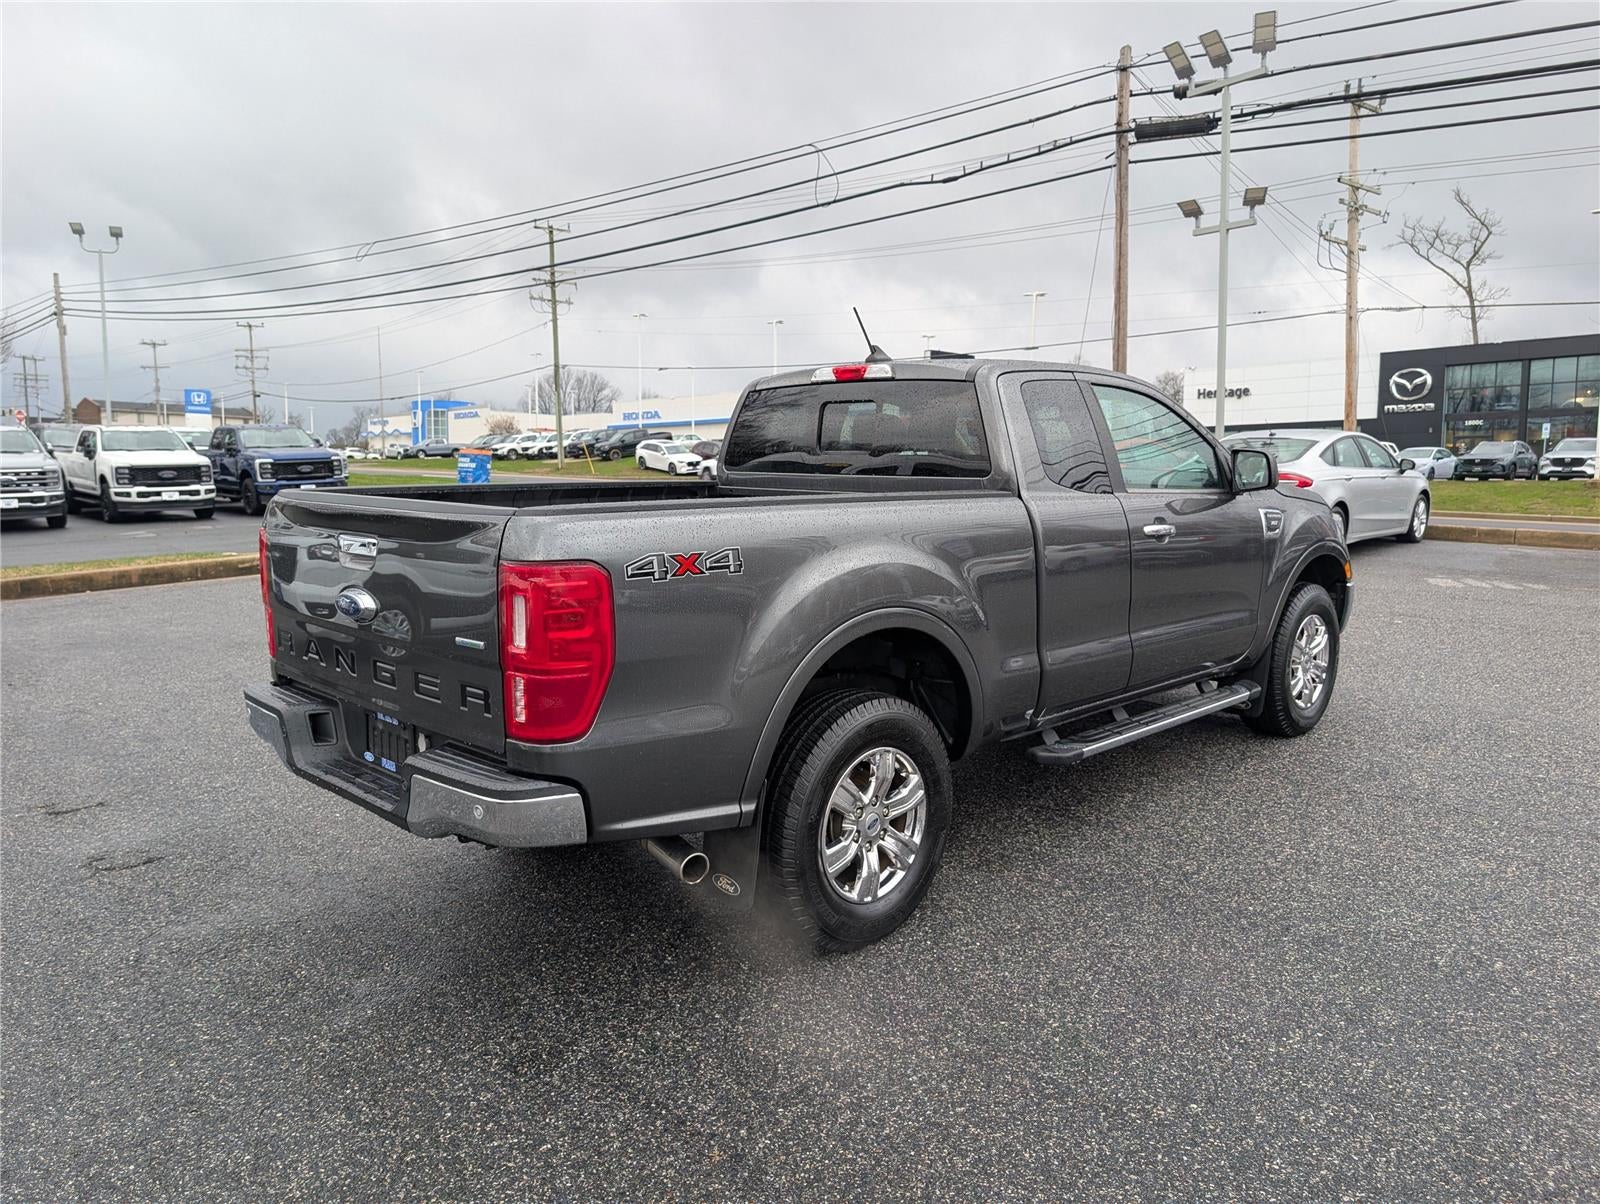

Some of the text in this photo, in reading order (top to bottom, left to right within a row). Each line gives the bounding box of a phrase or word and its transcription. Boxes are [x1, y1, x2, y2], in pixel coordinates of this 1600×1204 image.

[1197, 387, 1250, 399] Herage
[623, 410, 661, 421] HONDA
[278, 631, 492, 718] RANGER
[717, 876, 736, 893] Ford
